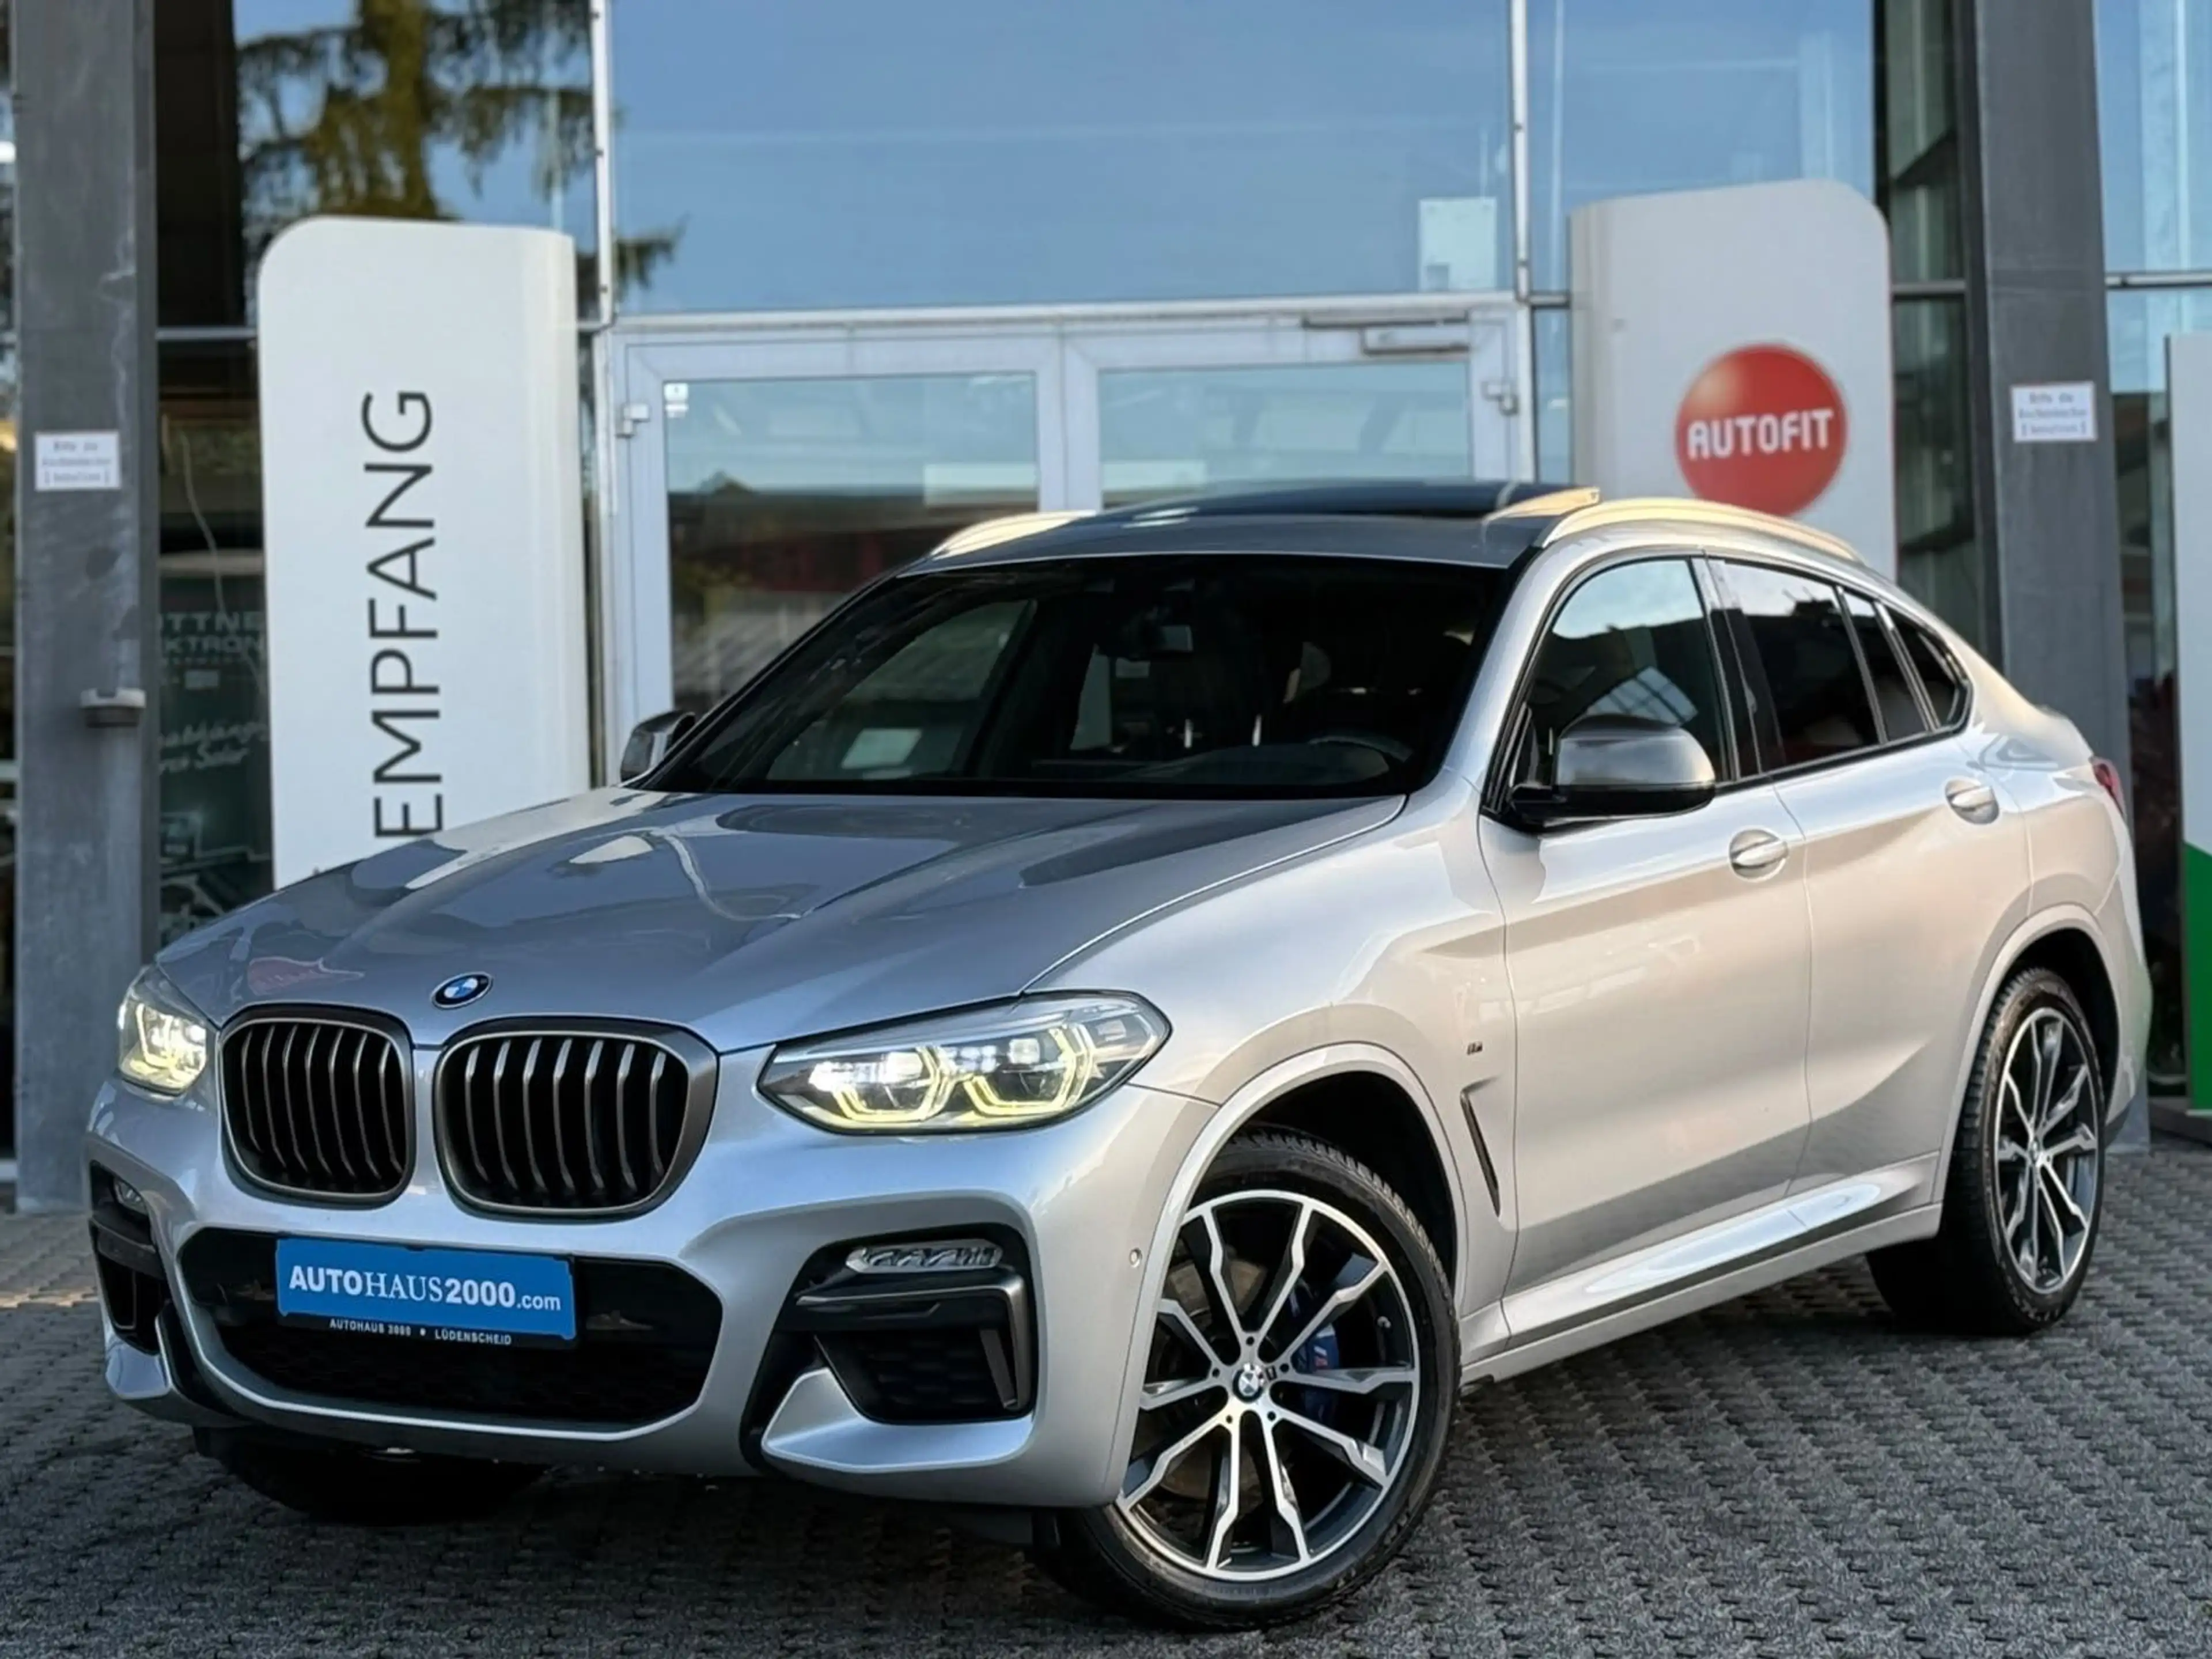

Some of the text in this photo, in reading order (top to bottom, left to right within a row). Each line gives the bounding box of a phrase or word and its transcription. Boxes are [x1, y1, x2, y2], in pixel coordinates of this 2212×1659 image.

[1687, 407, 1834, 461] AUTOFIT
[361, 389, 444, 838] EMPFANG
[289, 1264, 562, 1312] AUTOHAUS2000.com
[329, 1317, 385, 1334] AUTOHAUS
